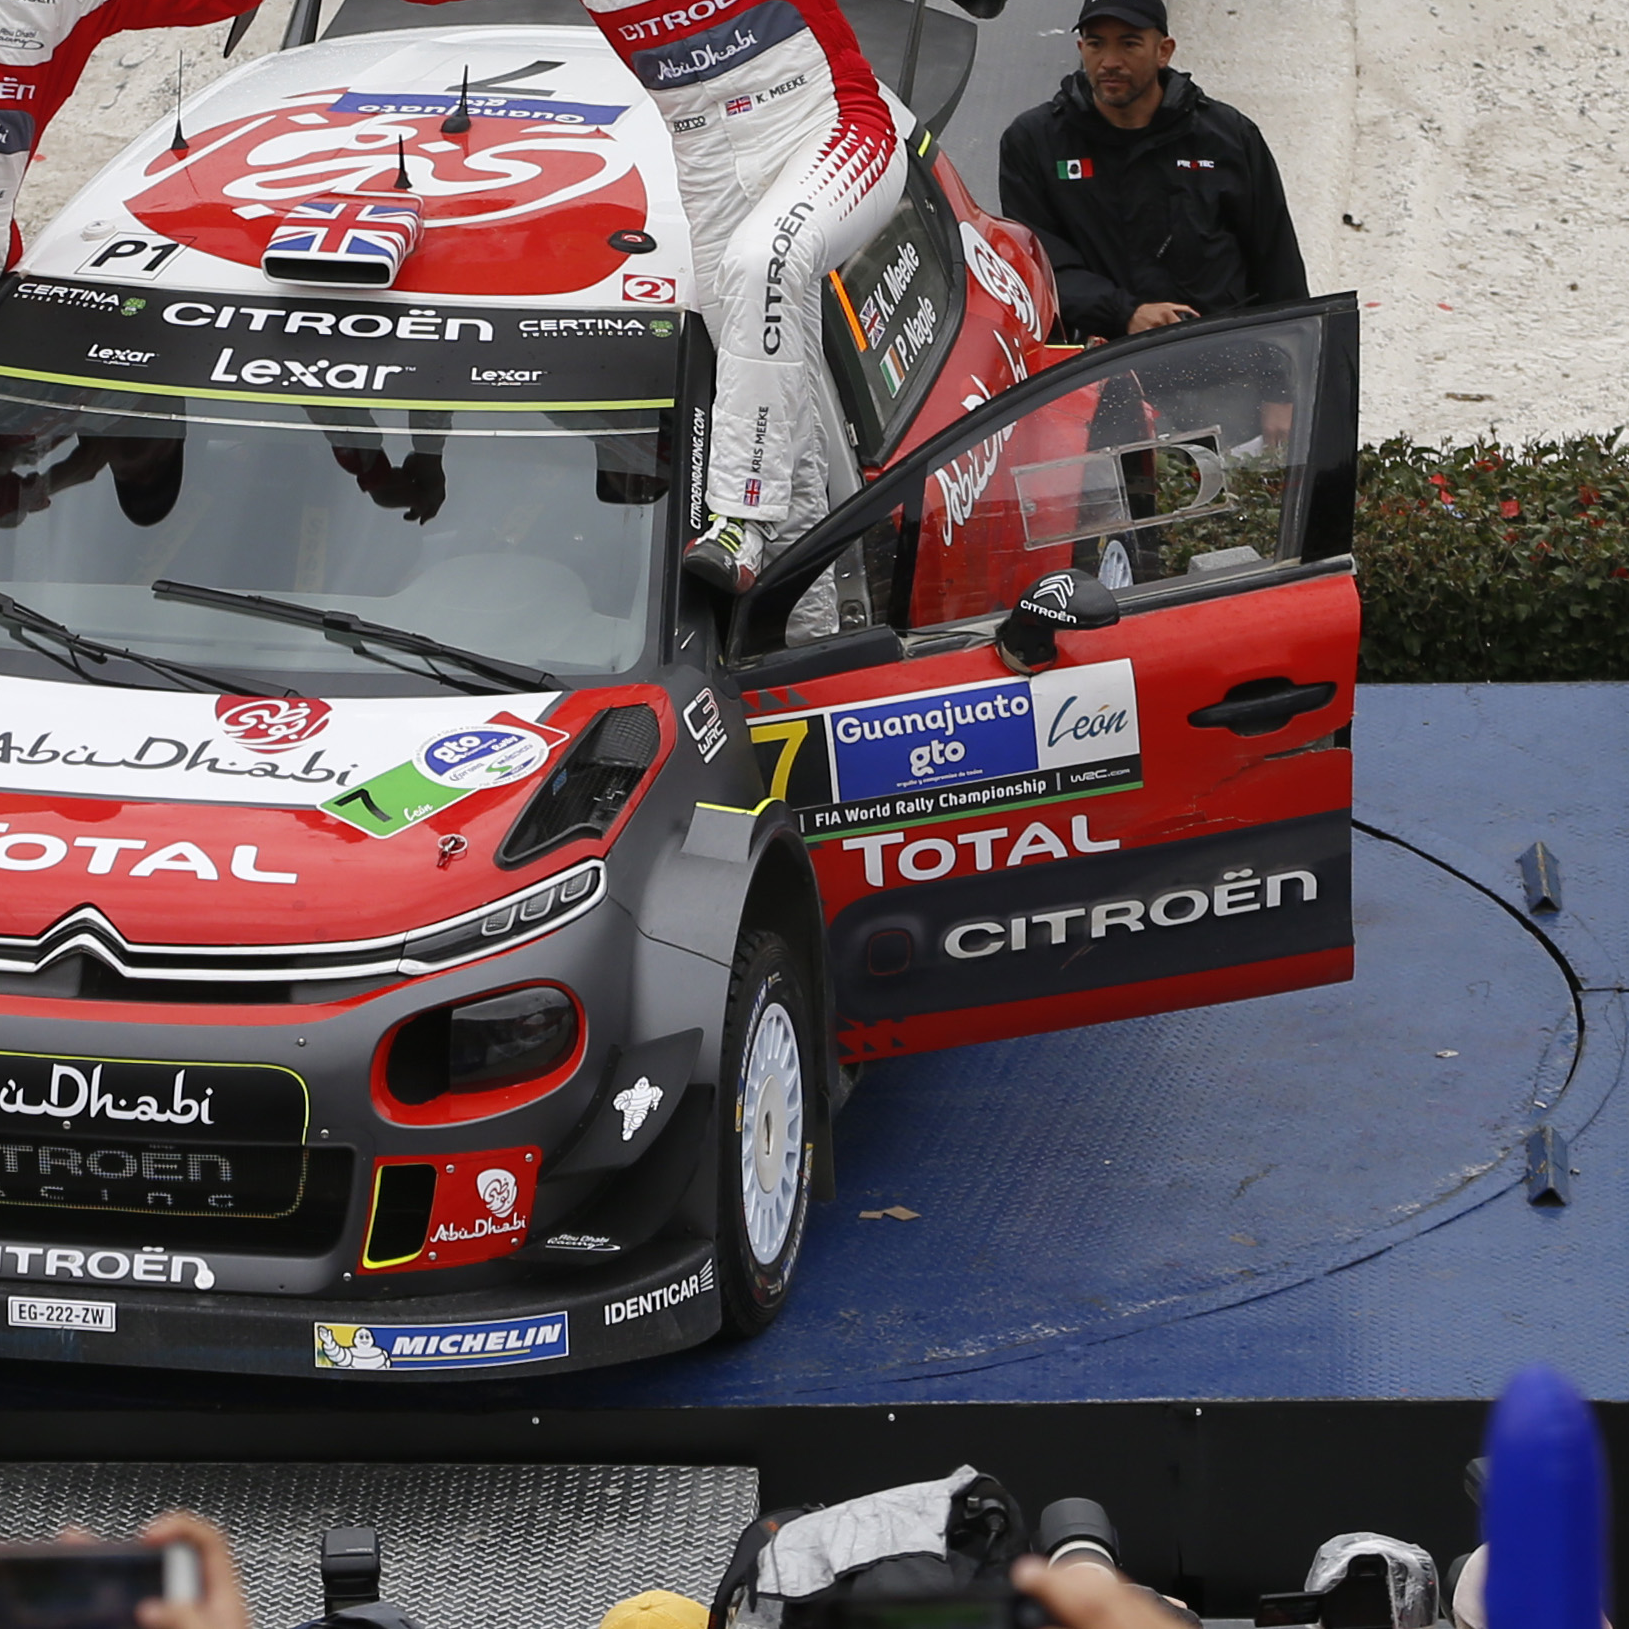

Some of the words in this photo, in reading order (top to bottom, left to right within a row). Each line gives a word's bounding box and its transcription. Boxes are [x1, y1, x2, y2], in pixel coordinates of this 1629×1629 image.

[755, 91, 769, 105] K.
[769, 75, 808, 101] MEEKE
[89, 240, 182, 272] P1
[882, 241, 920, 305] Meeke
[17, 282, 120, 307] CERTINA
[519, 319, 646, 331] CERTINA
[902, 295, 937, 357] Nagle
[87, 343, 156, 364] Lexar
[210, 347, 404, 392] Lexar
[471, 367, 543, 382] Lexar
[755, 405, 769, 445] MEEKE
[682, 687, 720, 741] C3
[836, 694, 1031, 744] Guanajuato
[1047, 695, 1128, 748] León
[433, 735, 482, 764] gto
[697, 719, 725, 755] WRC
[750, 719, 808, 800] 7
[909, 739, 967, 777] gto
[333, 788, 393, 823] 7
[403, 802, 435, 821] León
[814, 810, 842, 828] FIA
[844, 803, 892, 823] World
[895, 797, 935, 817] Rally
[938, 778, 1048, 809] Championship
[842, 813, 1121, 888] TOTAL
[17, 1303, 106, 1327] EG-222-ZW
[603, 1274, 700, 1326] IDENTICAR
[391, 1322, 562, 1356] MICHELIN
